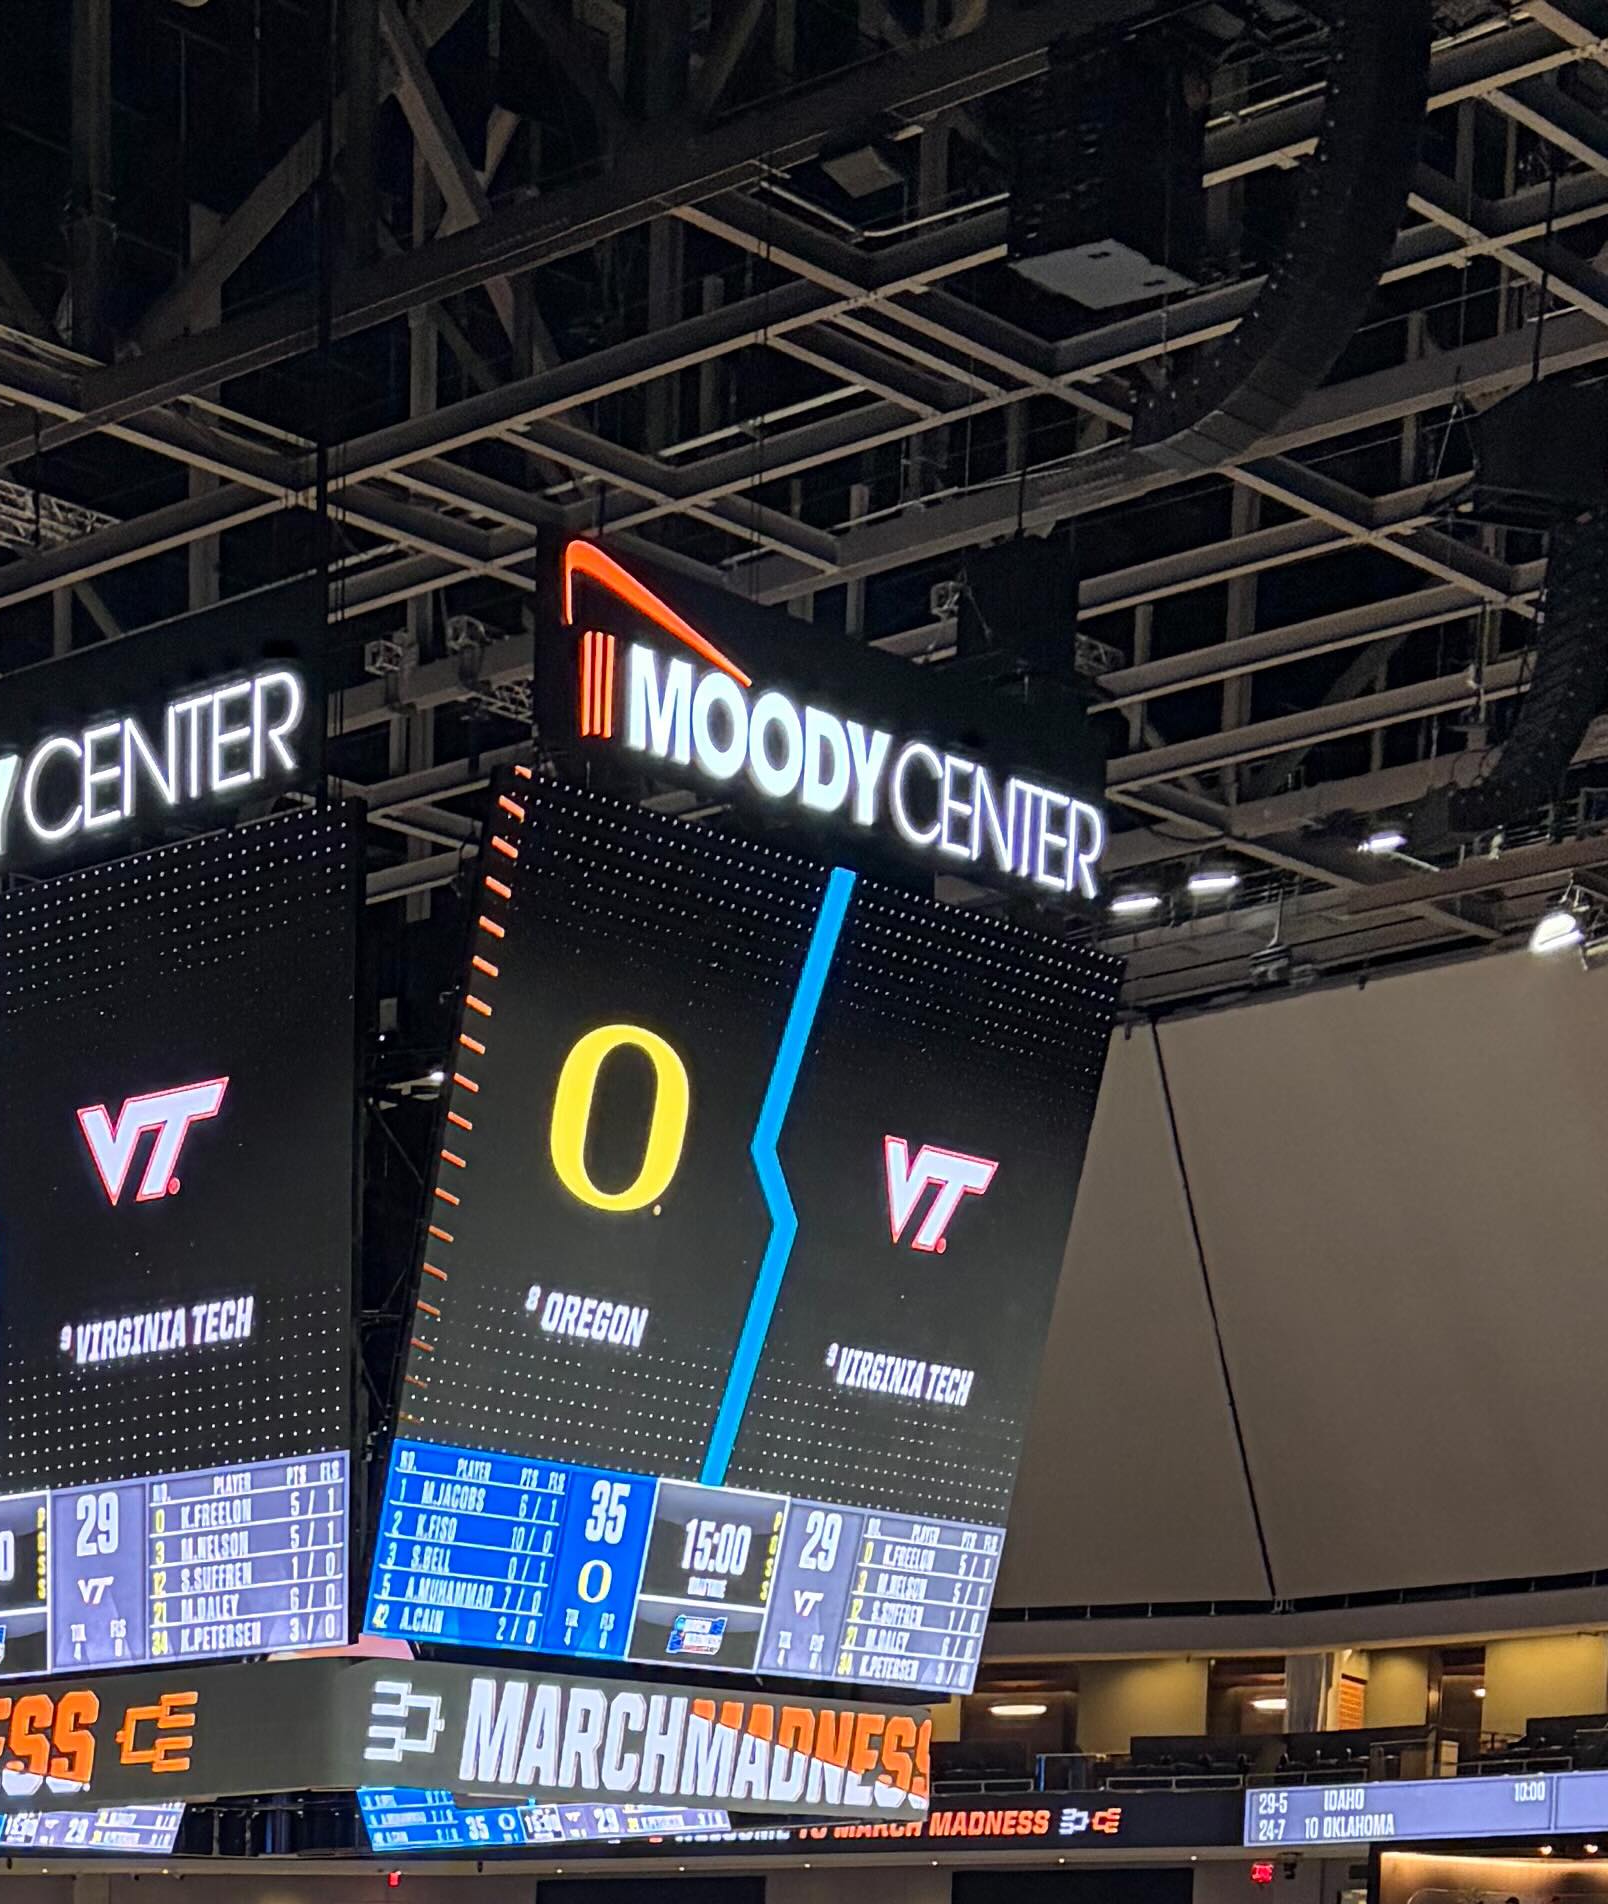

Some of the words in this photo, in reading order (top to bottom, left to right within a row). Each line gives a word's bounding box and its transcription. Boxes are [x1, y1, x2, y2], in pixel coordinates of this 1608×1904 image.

[24, 670, 304, 841] CENTER
[628, 643, 893, 828] MOODY
[894, 742, 1105, 899] CENTER
[76, 1076, 229, 1205] VT
[550, 1023, 689, 1212] O
[884, 1134, 999, 1254] VT
[60, 1325, 72, 1352] 9
[75, 1305, 188, 1364] VIRGINIA
[191, 1296, 255, 1344] TECH
[526, 1285, 542, 1311] 8
[540, 1291, 649, 1348] OREGON
[835, 1347, 925, 1397] VIRGINIA
[922, 1361, 974, 1407] TECH
[213, 1472, 252, 1496] PLAYER
[286, 1464, 307, 1486] PTS
[421, 1479, 486, 1512] M.JACOBS
[456, 1458, 492, 1481] PLAYER
[76, 1492, 119, 1557] 29
[181, 1498, 252, 1530] K.FREELON
[415, 1513, 458, 1542] K.FISO
[584, 1479, 631, 1545] 35
[798, 1510, 842, 1572] 29
[410, 1545, 451, 1573] S.BELL
[681, 1518, 752, 1576] 15:00
[181, 1621, 261, 1654] K.PETERSEN
[399, 1607, 444, 1634] A.CAIN
[928, 1810, 1050, 1836] MADNESS
[1259, 1793, 1287, 1814] 29-5
[1324, 1789, 1364, 1811] IDAHO
[1259, 1819, 1285, 1840] 24-7
[1305, 1818, 1318, 1838] 10
[1323, 1814, 1394, 1837] OKLAHOMA
